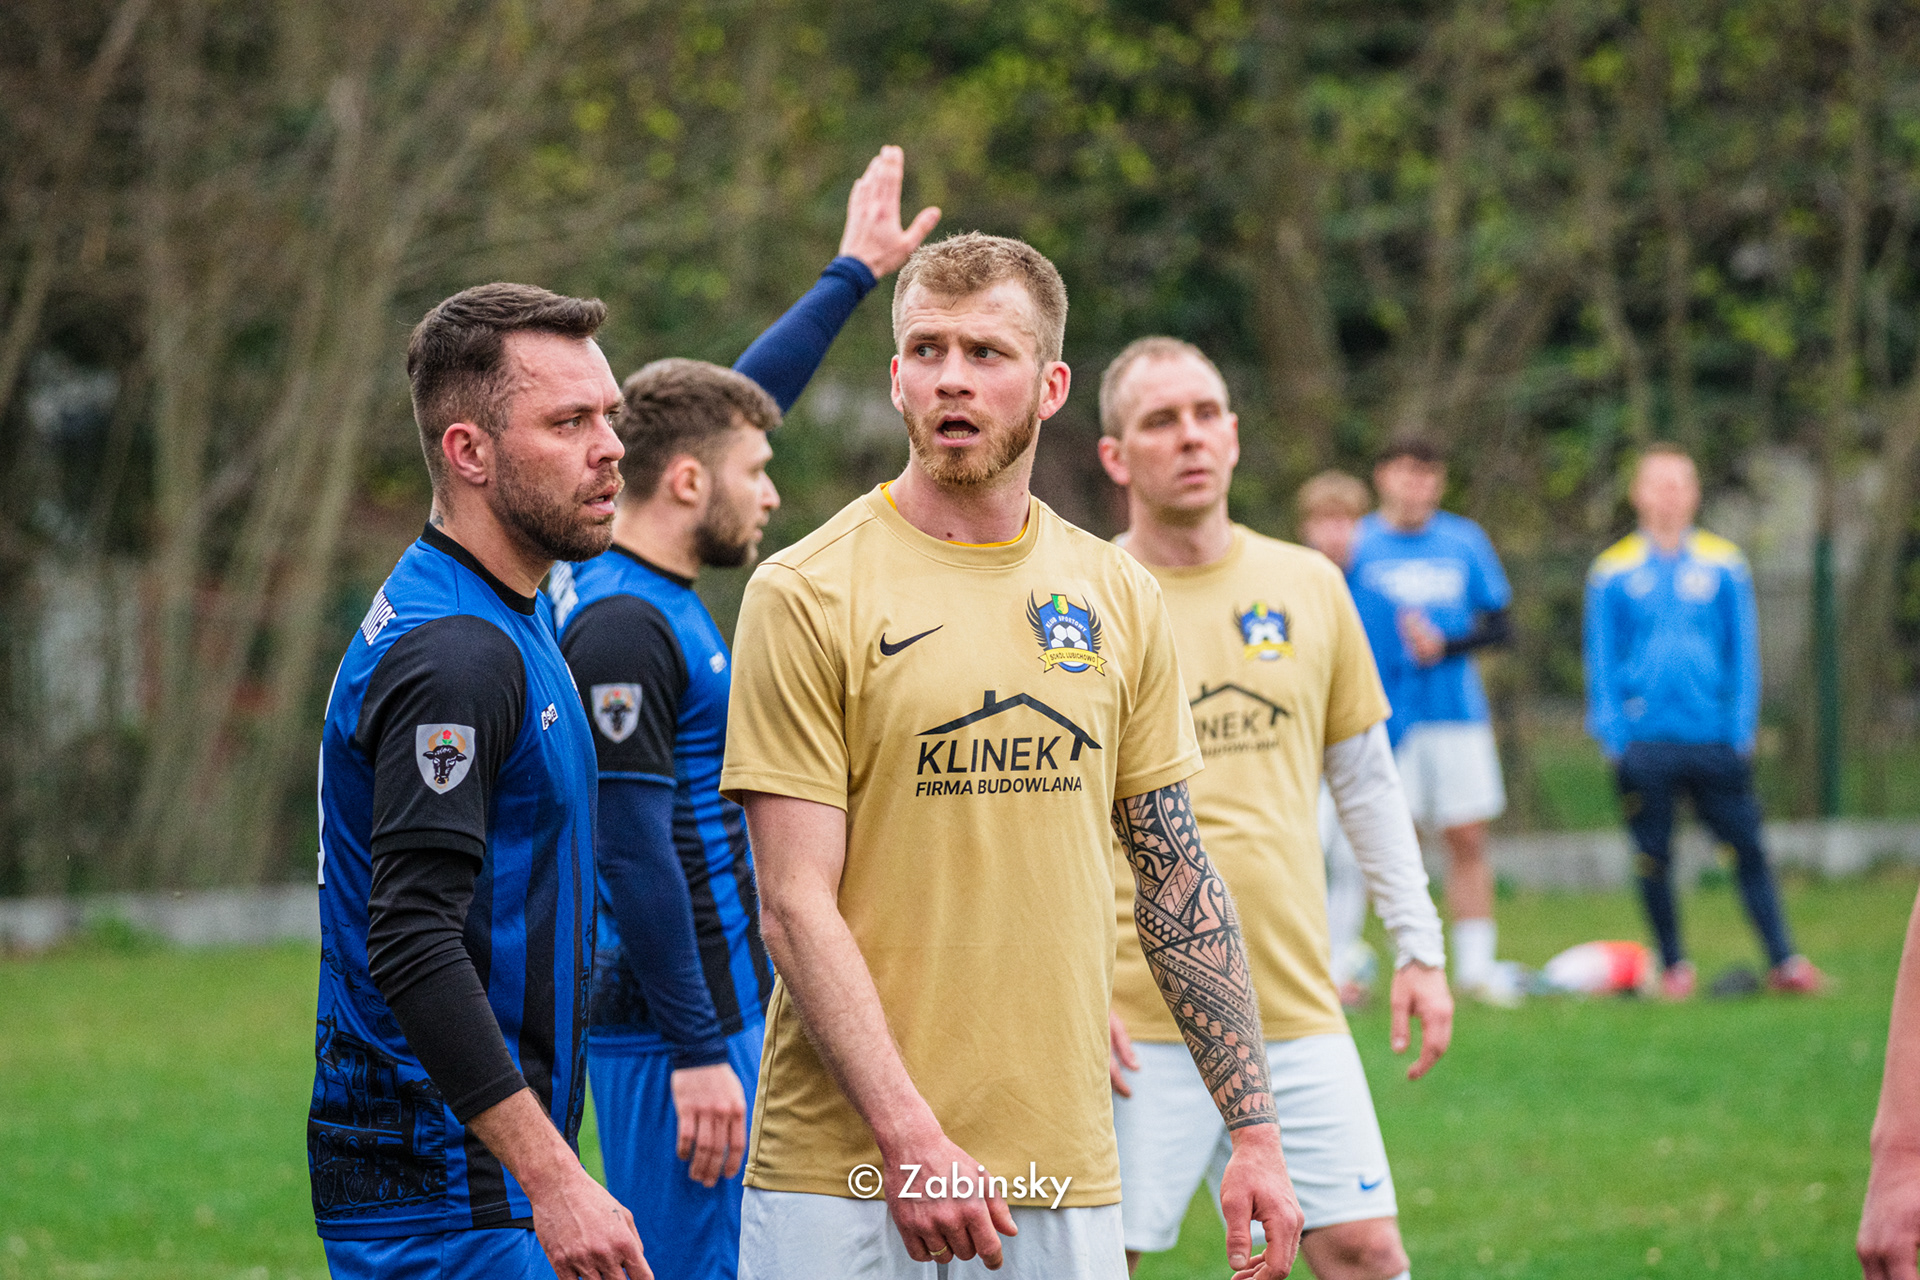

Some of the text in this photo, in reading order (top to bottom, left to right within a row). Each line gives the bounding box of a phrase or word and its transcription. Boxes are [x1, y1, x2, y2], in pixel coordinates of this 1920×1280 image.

[1045, 615, 1087, 632] KLUB SPORTOWY
[916, 736, 1062, 775] KLINEK
[915, 776, 1083, 797] FIRMA BUDOWLANA
